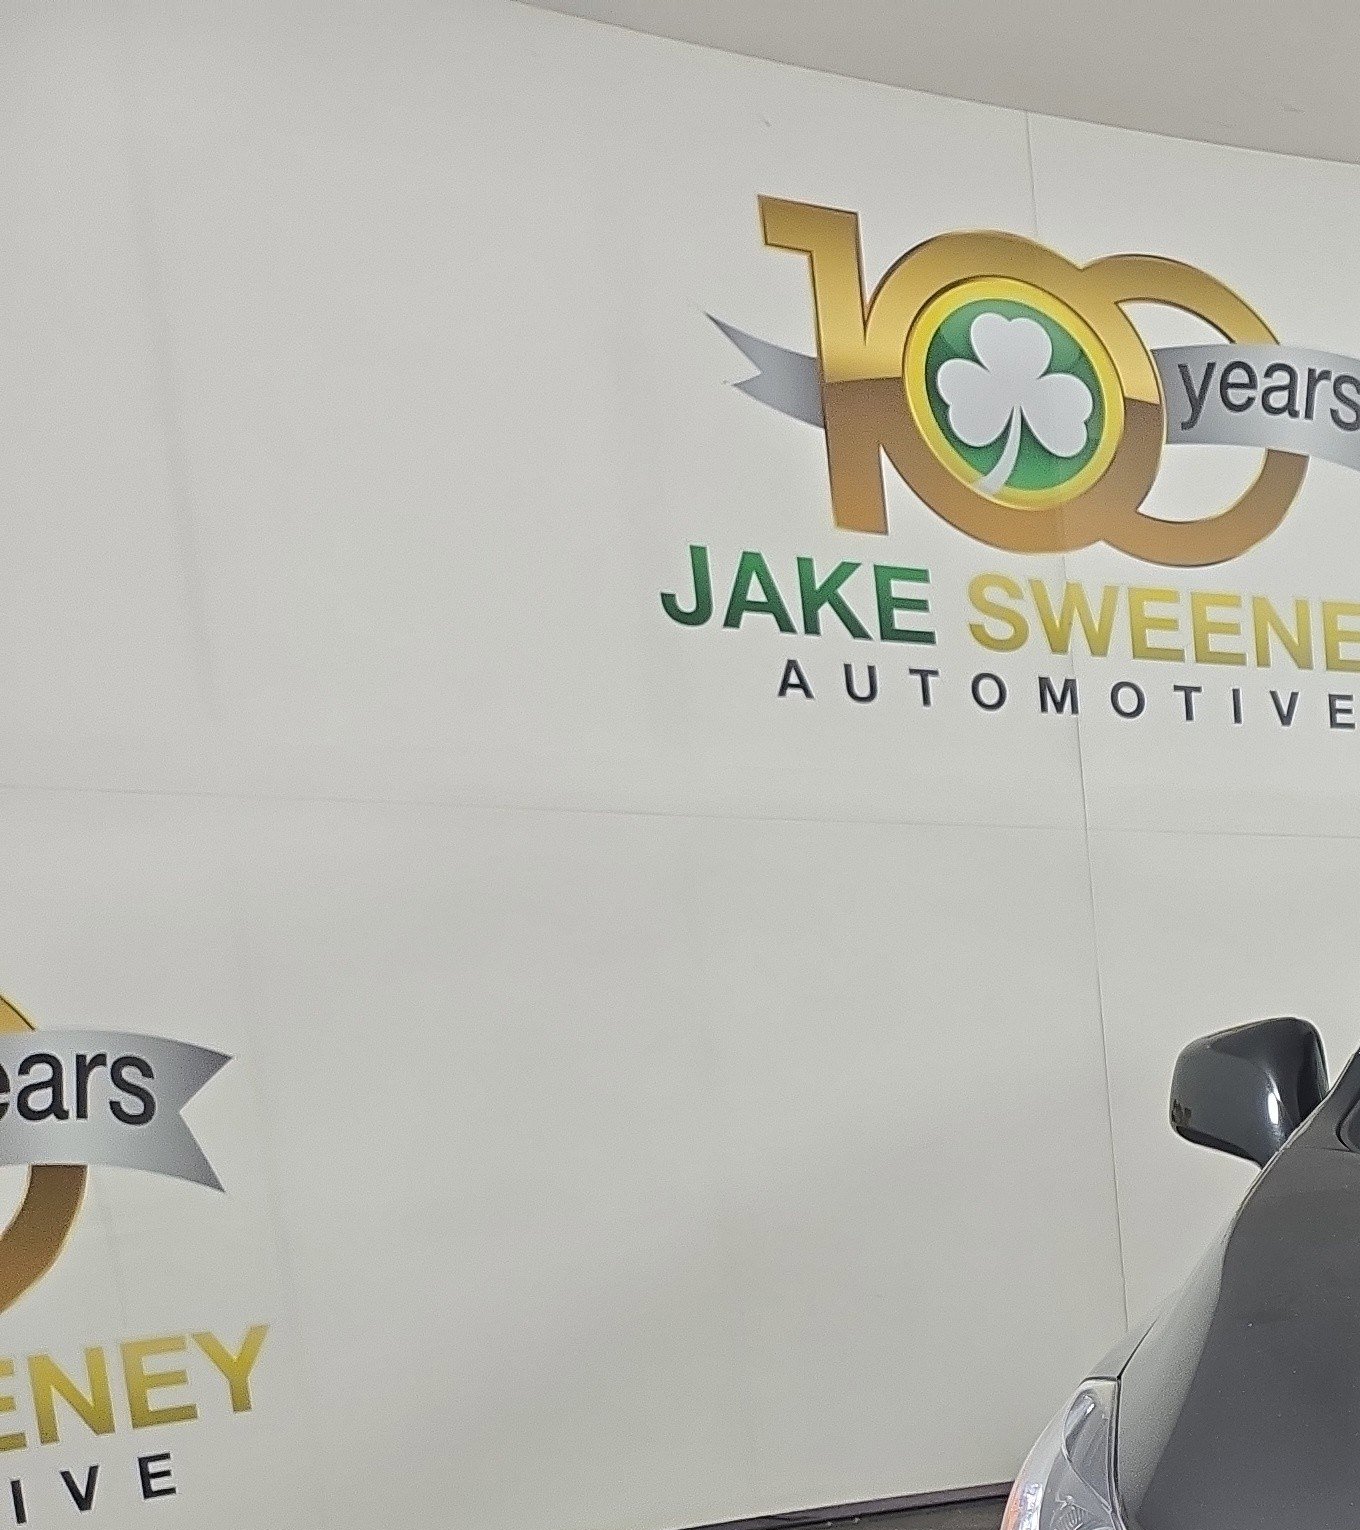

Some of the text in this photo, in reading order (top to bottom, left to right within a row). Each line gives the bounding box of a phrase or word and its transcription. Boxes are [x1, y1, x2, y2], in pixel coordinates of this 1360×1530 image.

[660, 544, 937, 645] JAKE
[776, 660, 1357, 729] AUTOMOTIVE
[0, 1052, 156, 1125] ars
[10, 1453, 177, 1524] IVE
